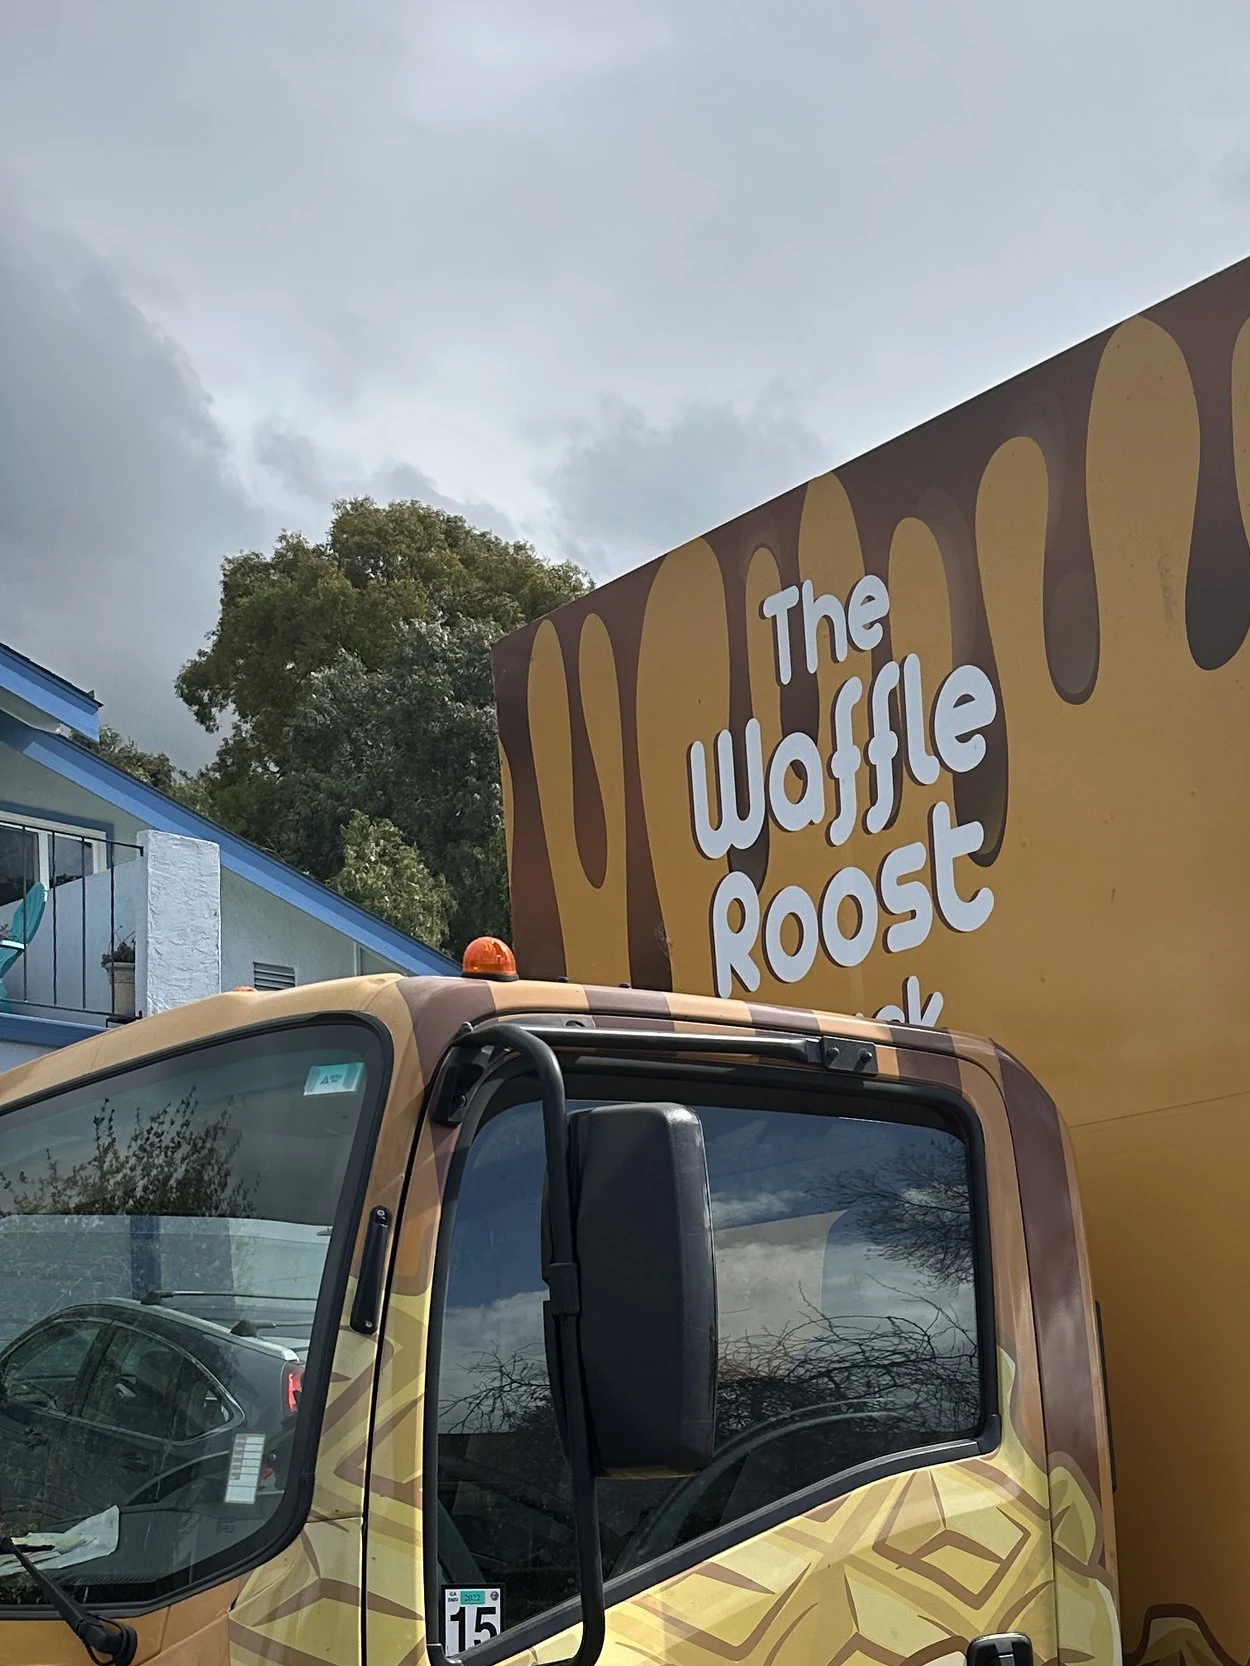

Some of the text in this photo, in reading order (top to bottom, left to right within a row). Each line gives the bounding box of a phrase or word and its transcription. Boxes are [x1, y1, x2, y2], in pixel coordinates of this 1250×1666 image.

[763, 575, 889, 685] The
[690, 653, 997, 859] Waffle
[713, 801, 994, 999] Roost
[450, 1607, 497, 1653] 15
